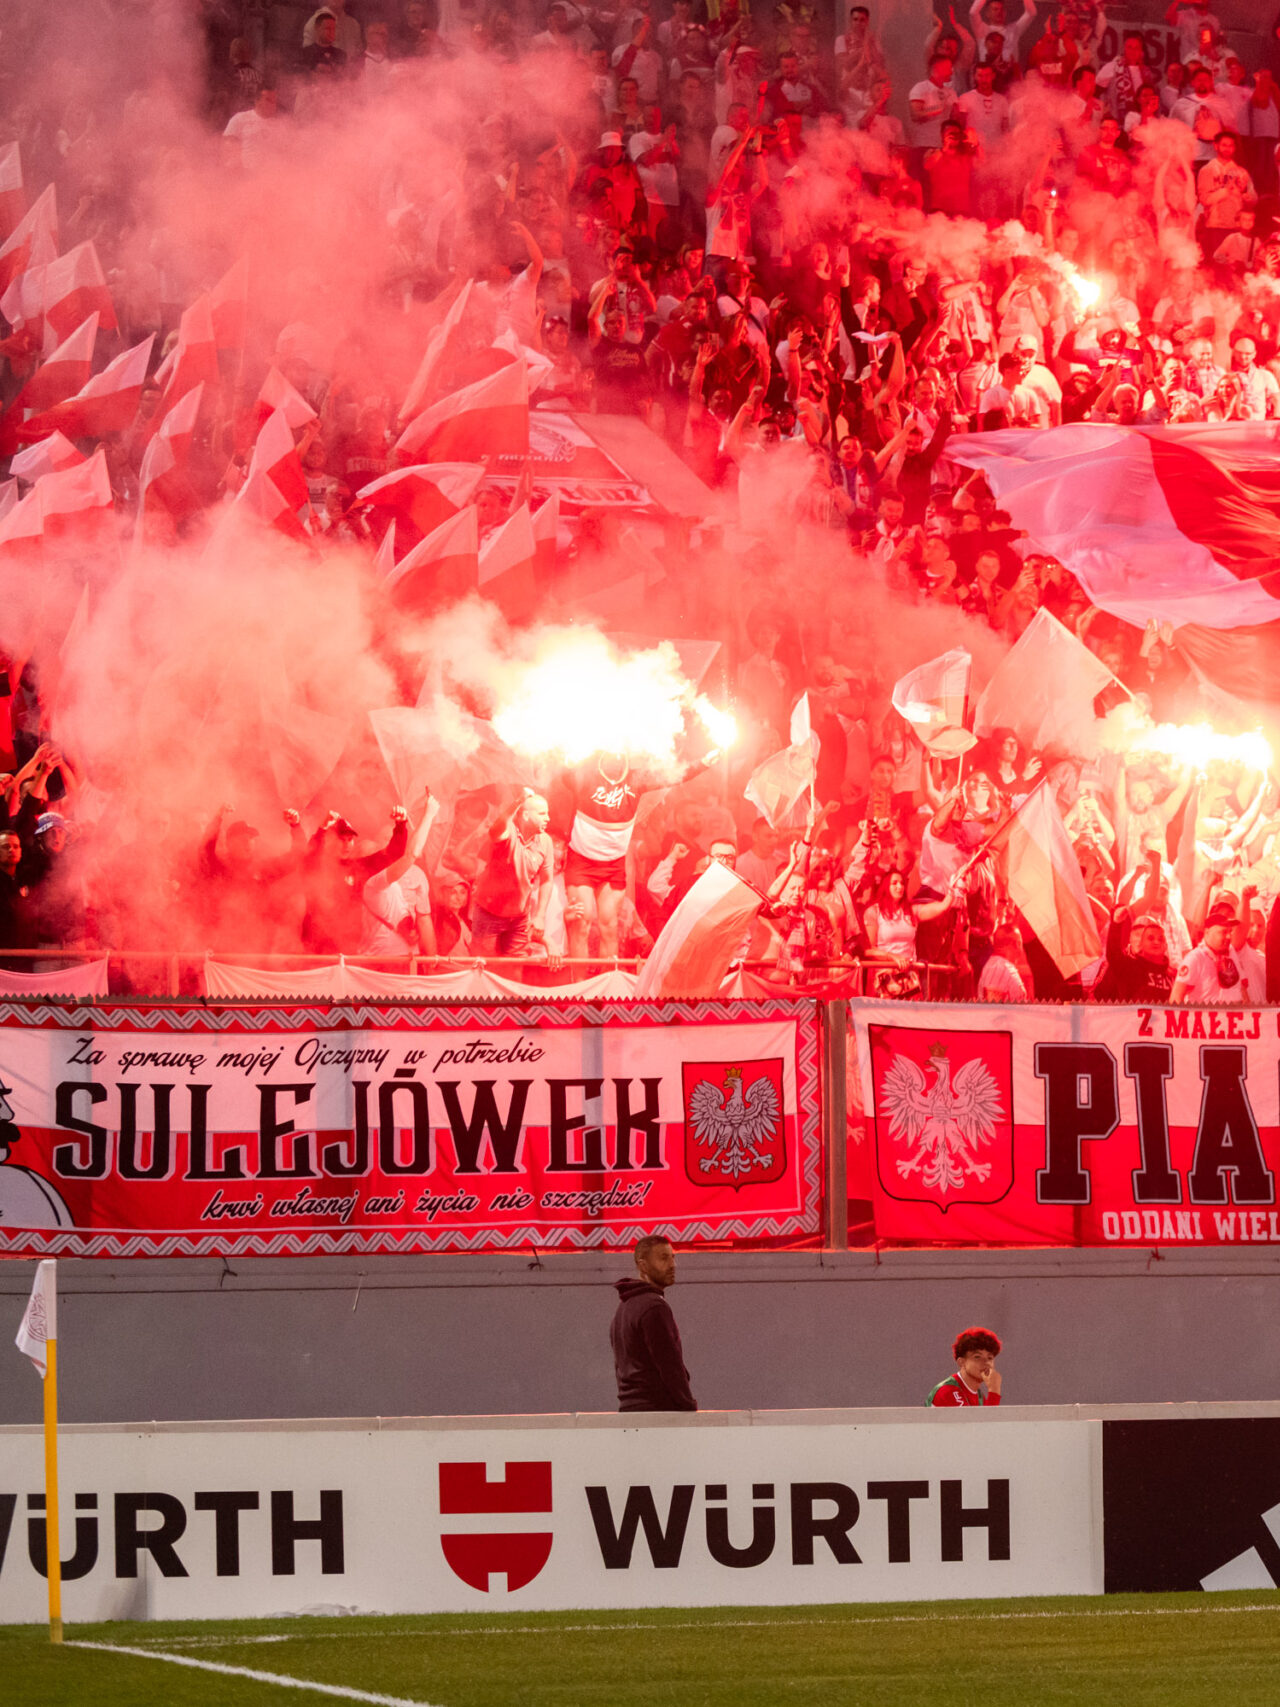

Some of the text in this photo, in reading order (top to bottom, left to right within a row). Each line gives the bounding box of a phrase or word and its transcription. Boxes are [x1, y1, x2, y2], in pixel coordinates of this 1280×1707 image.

[1138, 1008, 1153, 1037] Z
[1164, 1009, 1261, 1039] MAŁEJ
[66, 1036, 545, 1076] Za sprawę mojej Ojczyzny w potrzebie
[52, 1066, 668, 1181] SULEJÓWEK
[201, 1178, 654, 1224] krwi własnej ani życia nie szczędzić!
[1102, 1210, 1204, 1240] ODDANI
[0, 1490, 346, 1581] ÜRTH
[585, 1477, 1011, 1569] WÜRTH
